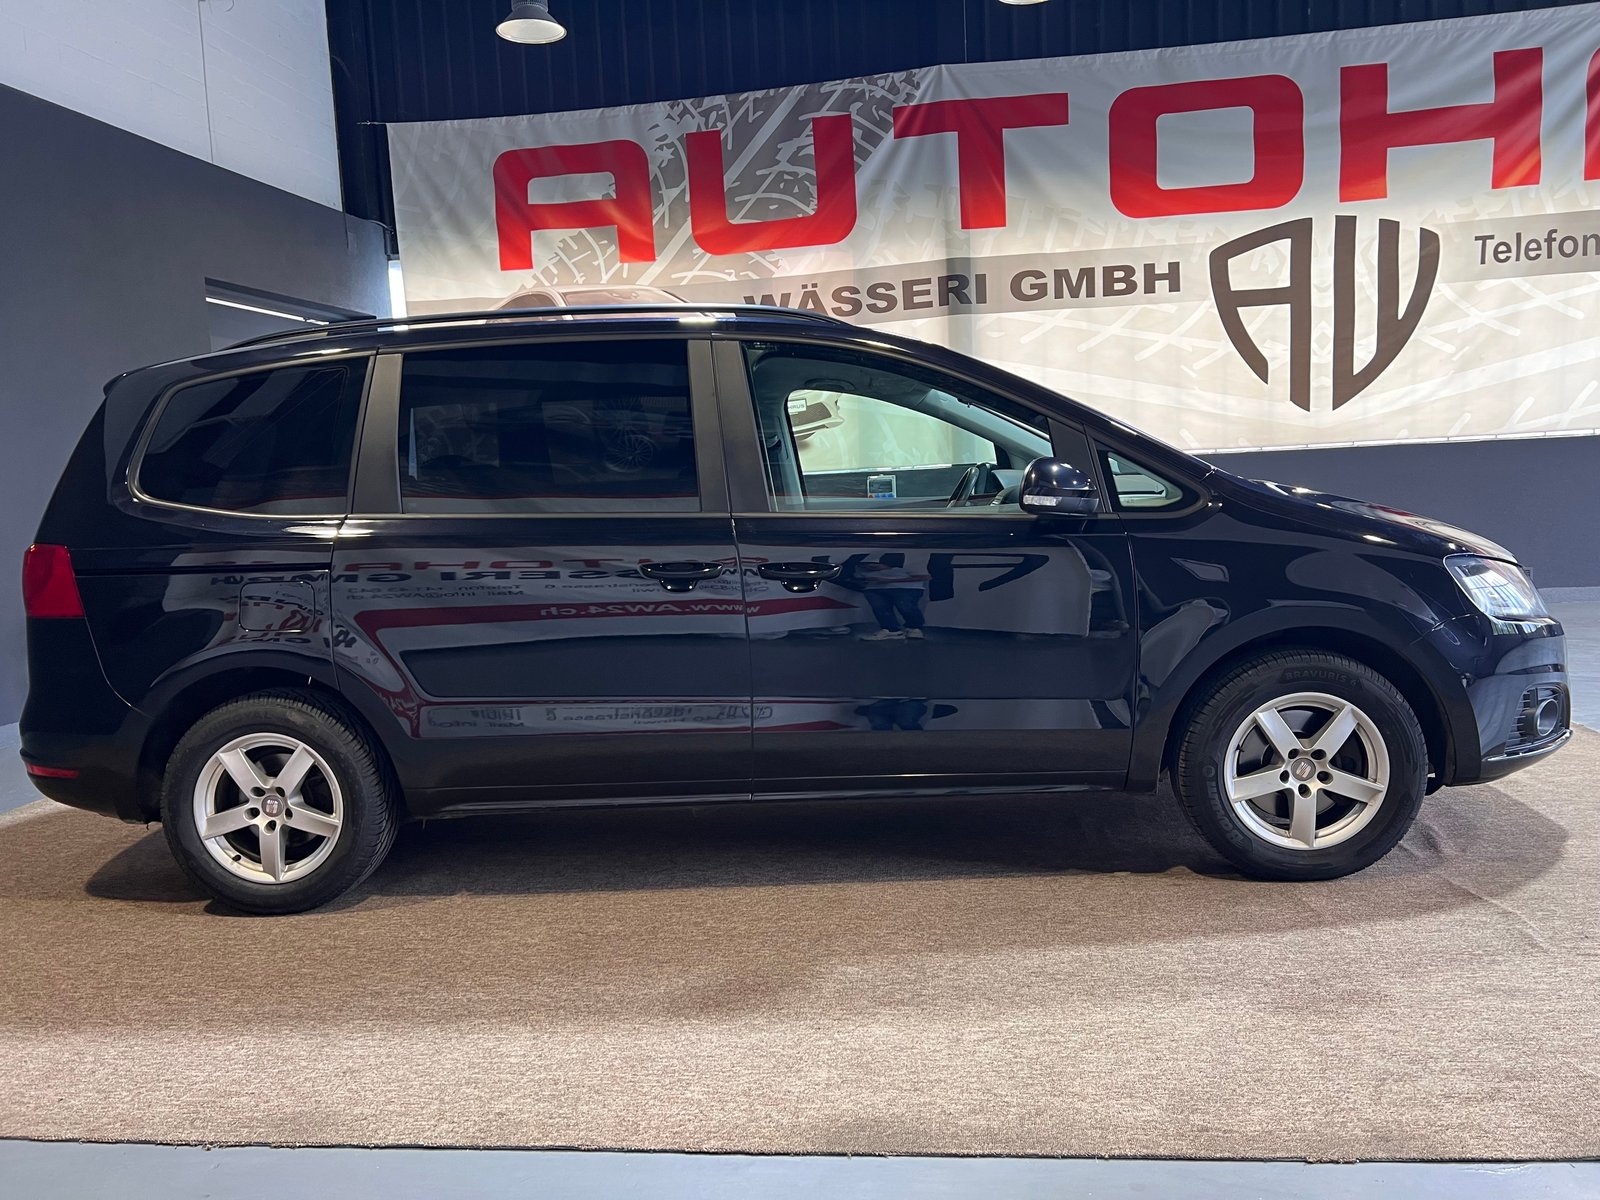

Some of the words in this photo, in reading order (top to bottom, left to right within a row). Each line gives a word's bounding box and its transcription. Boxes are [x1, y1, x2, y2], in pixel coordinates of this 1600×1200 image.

[493, 47, 1600, 272] AUTOH
[1474, 229, 1600, 265] Telefon
[1010, 261, 1181, 303] GMBH
